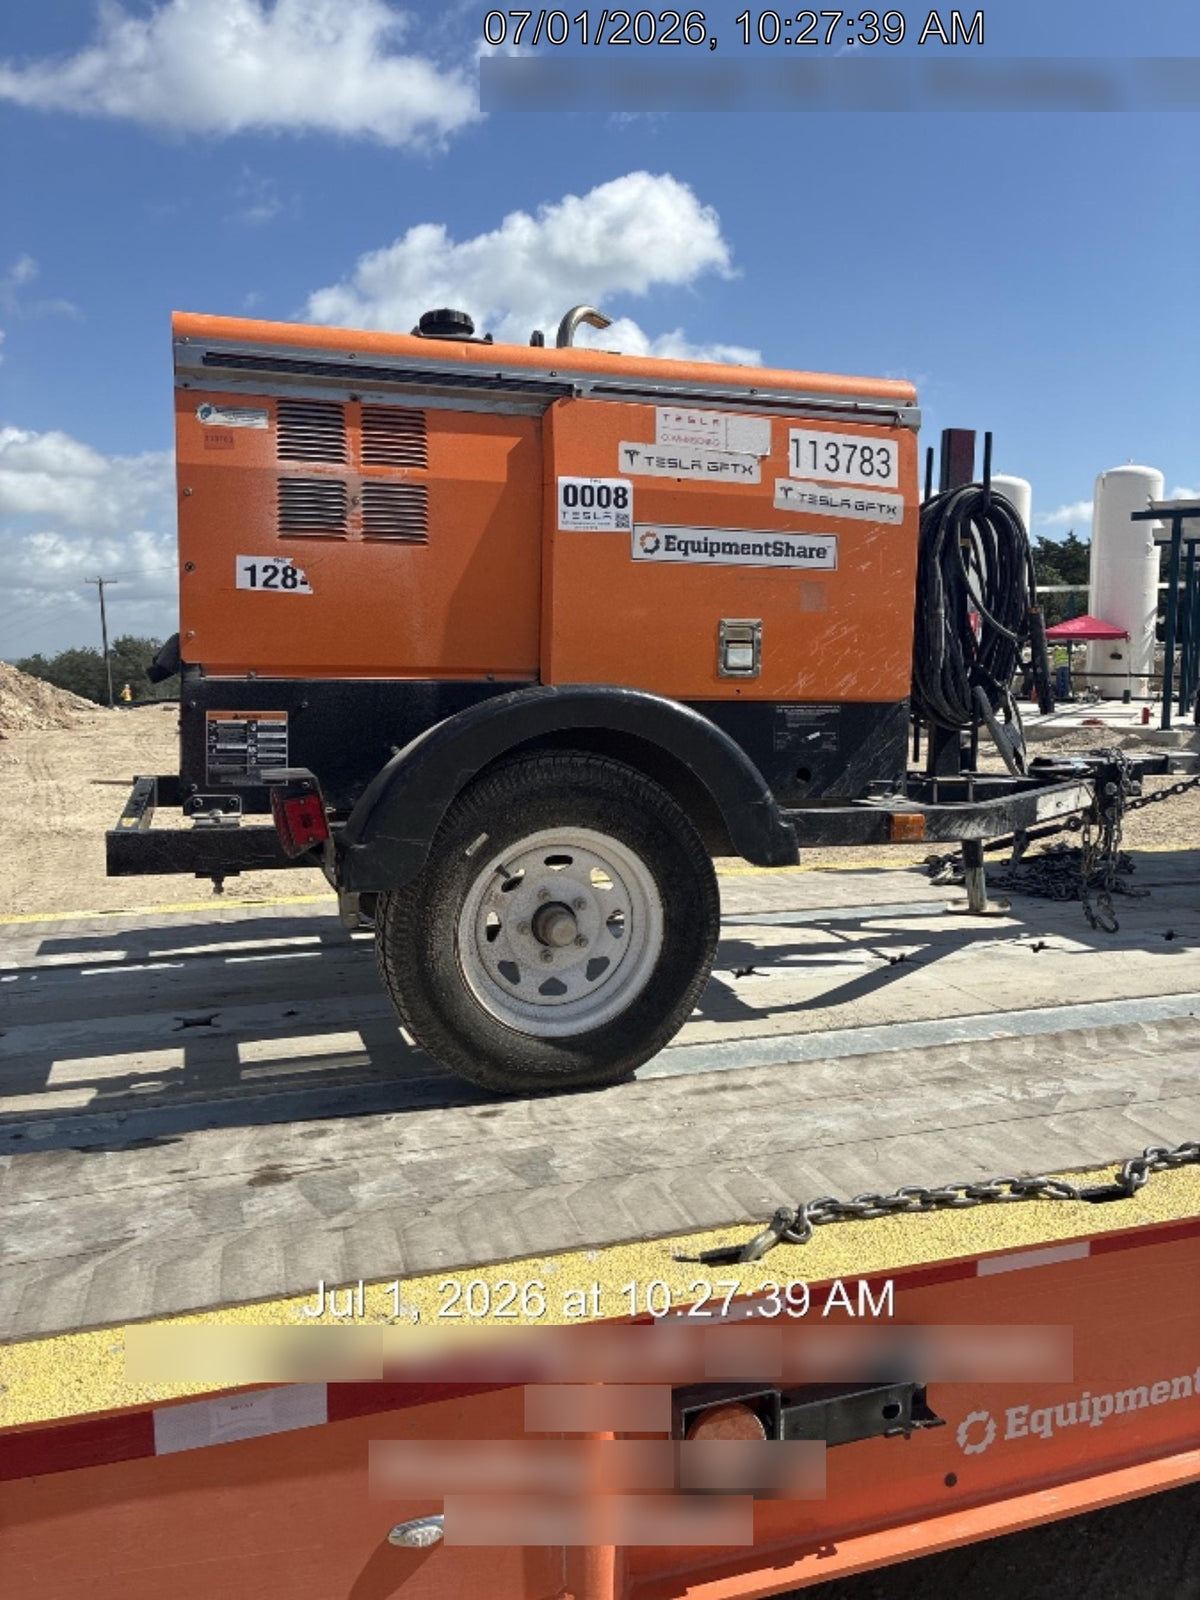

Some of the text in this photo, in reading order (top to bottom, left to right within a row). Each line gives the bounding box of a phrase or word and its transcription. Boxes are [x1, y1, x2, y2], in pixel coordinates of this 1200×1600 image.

[644, 456, 702, 471] TESLA
[791, 438, 891, 479] 113783
[563, 484, 628, 509] 0008
[800, 493, 851, 509] TESLA
[562, 511, 613, 520] TESLA
[243, 563, 309, 589] 128
